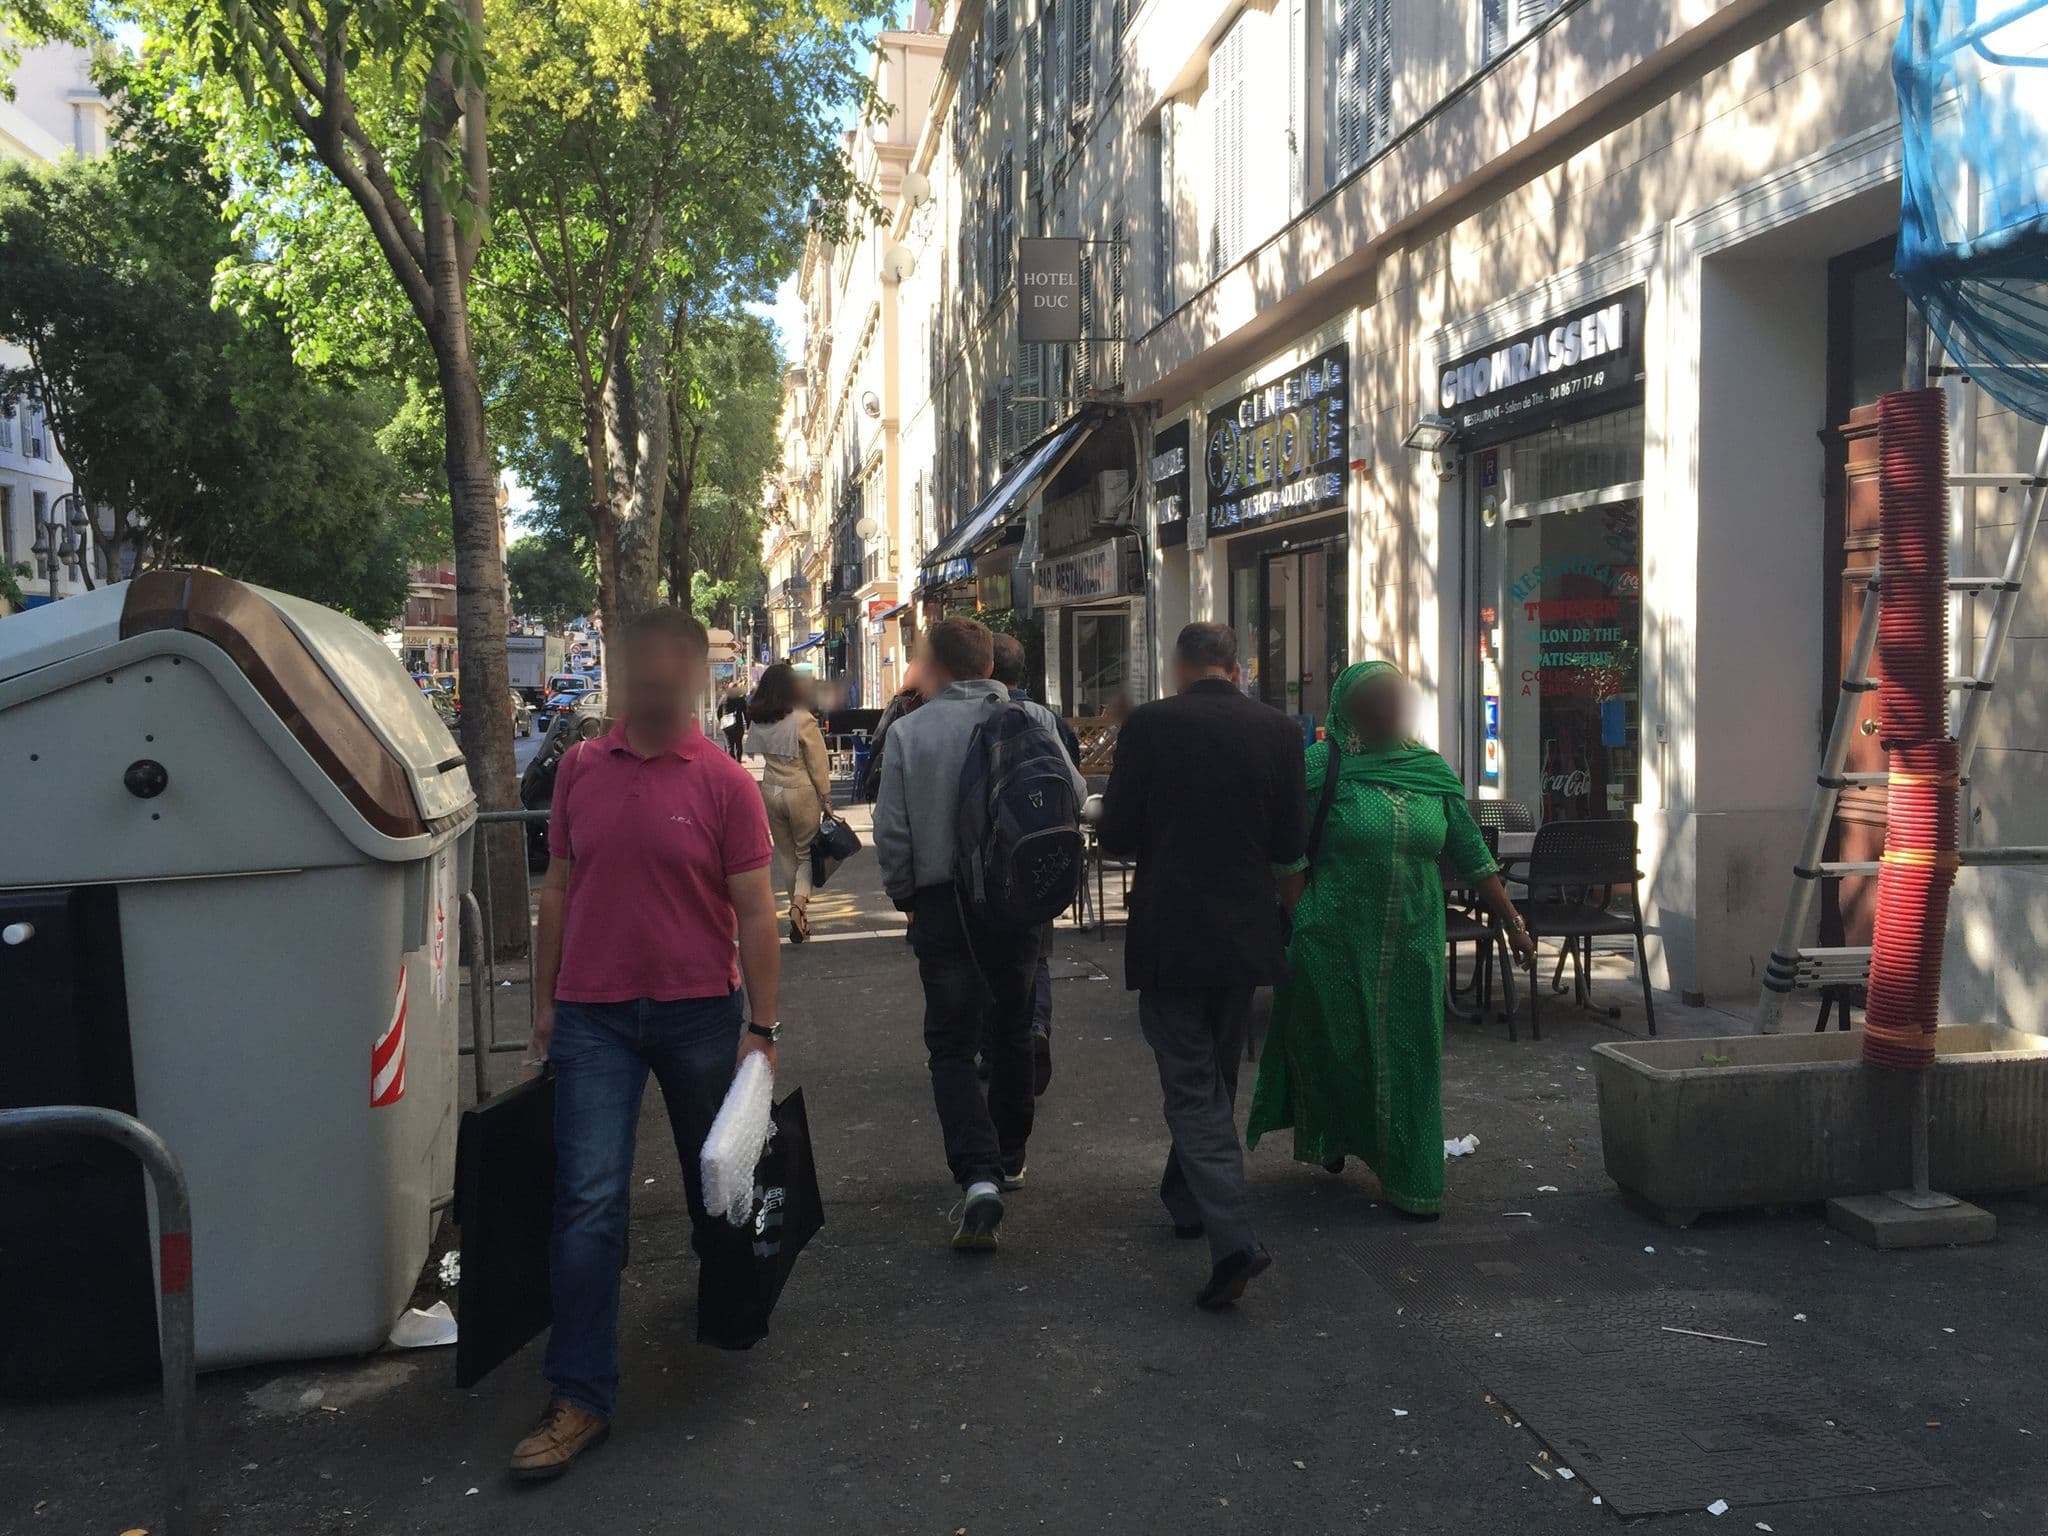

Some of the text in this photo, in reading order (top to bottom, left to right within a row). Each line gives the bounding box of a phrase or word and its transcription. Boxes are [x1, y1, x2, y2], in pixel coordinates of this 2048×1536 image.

[1024, 272, 1078, 286] HOTEL
[1034, 295, 1069, 308] DUC
[1440, 303, 1624, 409] GHOMRASSEN
[1238, 358, 1340, 429] CINEMA
[1463, 405, 1500, 427] RESTAURANT
[1505, 397, 1522, 414] Salon
[1522, 396, 1532, 408] de
[1549, 387, 1560, 400] 04
[1560, 383, 1571, 396] 86
[1571, 378, 1581, 393] 77
[1583, 374, 1593, 390] 17
[1594, 370, 1605, 387] 49
[1252, 490, 1272, 517] SHOP
[1038, 567, 1052, 592] BAR
[1571, 627, 1590, 643] DE
[1592, 626, 1622, 642] THE
